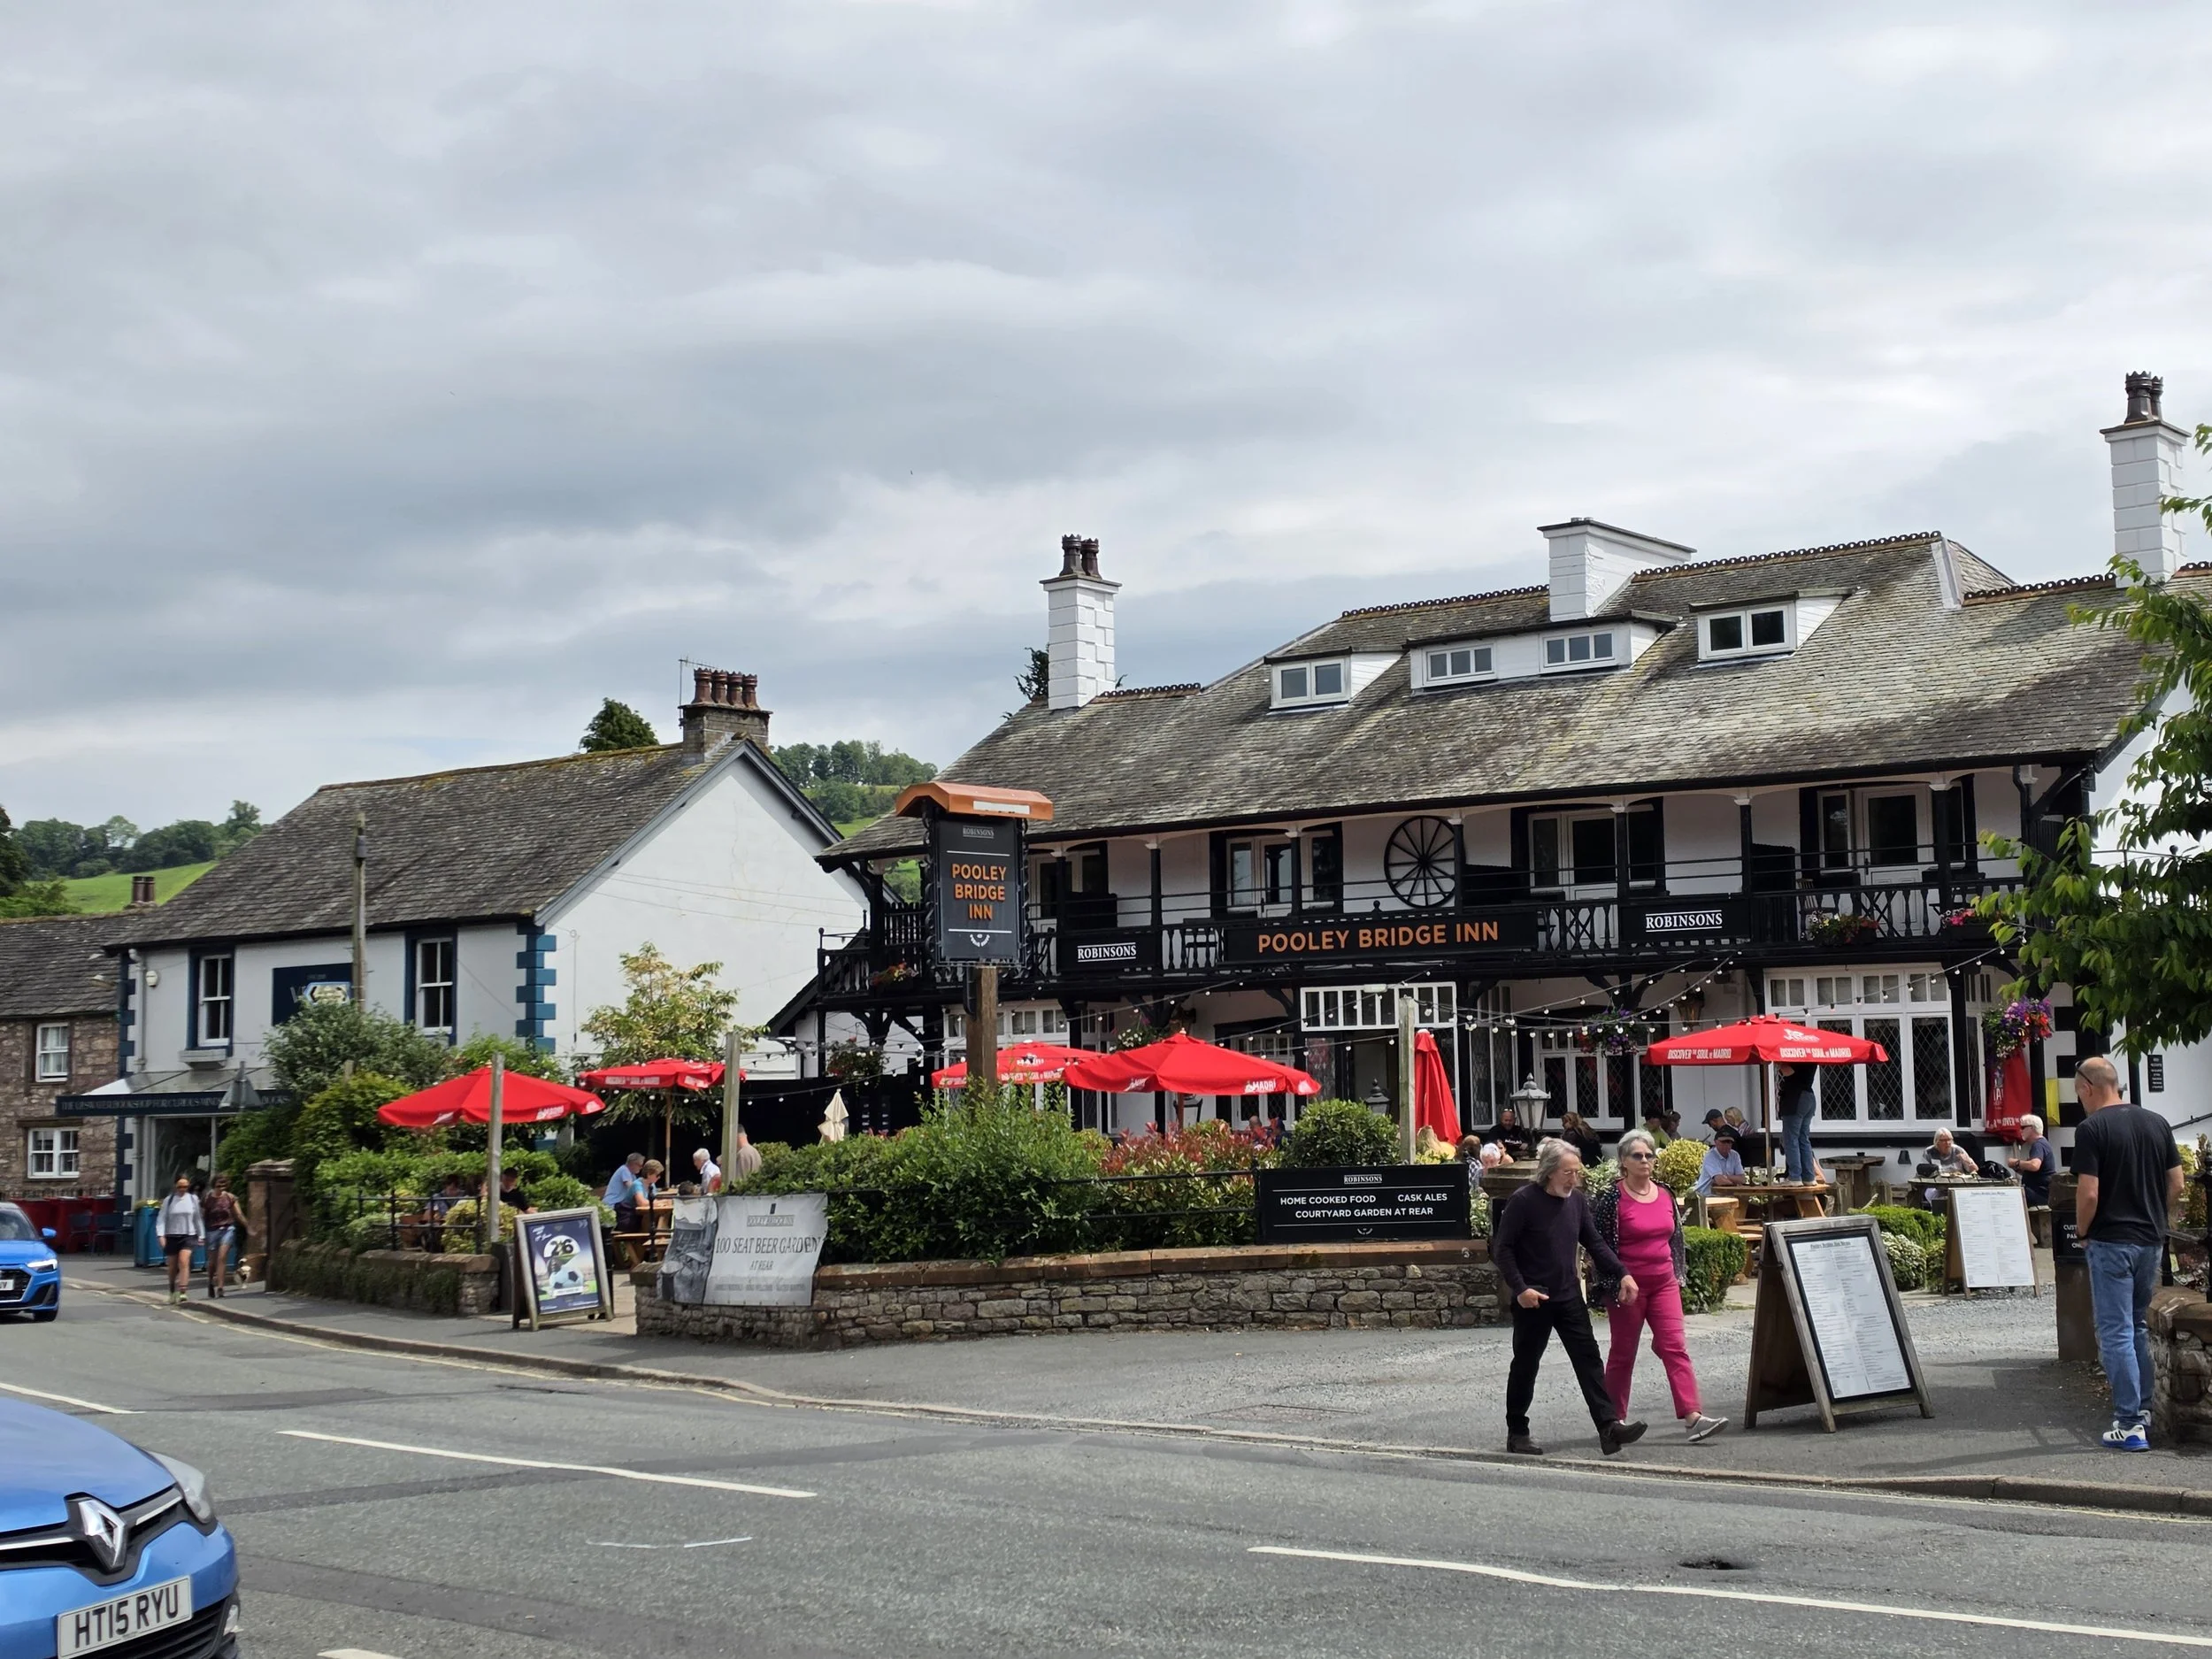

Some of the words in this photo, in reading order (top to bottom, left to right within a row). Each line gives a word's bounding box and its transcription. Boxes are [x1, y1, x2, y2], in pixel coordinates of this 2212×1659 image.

[963, 826, 995, 837] ROBINSONS
[951, 864, 1007, 880] POOLEY
[955, 884, 1006, 901] BRIDGE
[969, 903, 993, 919] INN
[1646, 912, 1723, 929] ROBINSONS
[1258, 930, 1349, 953] POOLEY
[1358, 924, 1448, 948] BRIDGE
[1455, 921, 1498, 942] INN
[1077, 945, 1137, 960] ROBINSONS
[1667, 1048, 1692, 1060] DISCOVER
[1696, 1048, 1709, 1060] SOUL
[1712, 1048, 1732, 1059] MADRID
[1779, 1047, 1807, 1058] DISCOVER
[1811, 1047, 1825, 1058] SOUL
[1829, 1047, 1852, 1058] MADRID
[1344, 1175, 1383, 1184] ROBINSONS
[1309, 1195, 1348, 1204] COOKED
[1349, 1194, 1376, 1203] FOOD
[1397, 1194, 1422, 1202] CASK
[1425, 1193, 1448, 1202] ALES
[1295, 1209, 1352, 1218] COURTYARD
[1354, 1208, 1392, 1217] GARDEN
[1409, 1207, 1433, 1216] REAR
[715, 1238, 732, 1254] 100
[733, 1238, 755, 1254] SEAT
[756, 1238, 779, 1254] BEER
[779, 1237, 821, 1254] GARDEN
[749, 1260, 758, 1271] AT
[758, 1260, 774, 1271] REAR
[75, 1600, 129, 1648] HT15
[136, 1584, 178, 1630] RYU
